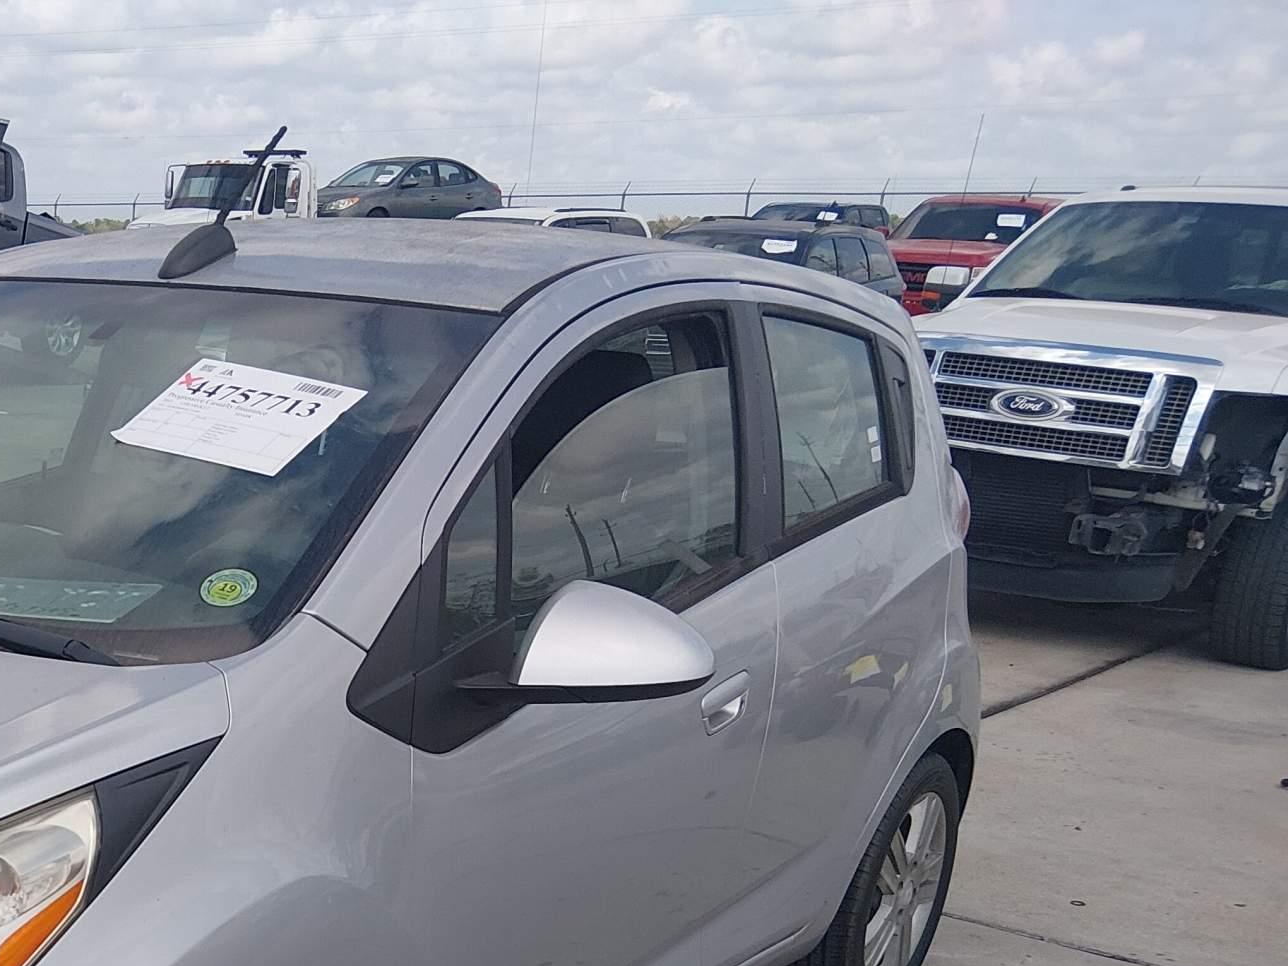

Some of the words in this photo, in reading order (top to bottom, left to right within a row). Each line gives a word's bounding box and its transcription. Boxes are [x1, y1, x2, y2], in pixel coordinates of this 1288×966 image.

[187, 380, 321, 417] 44757713
[1010, 396, 1045, 411] Ford
[218, 583, 238, 593] 19
